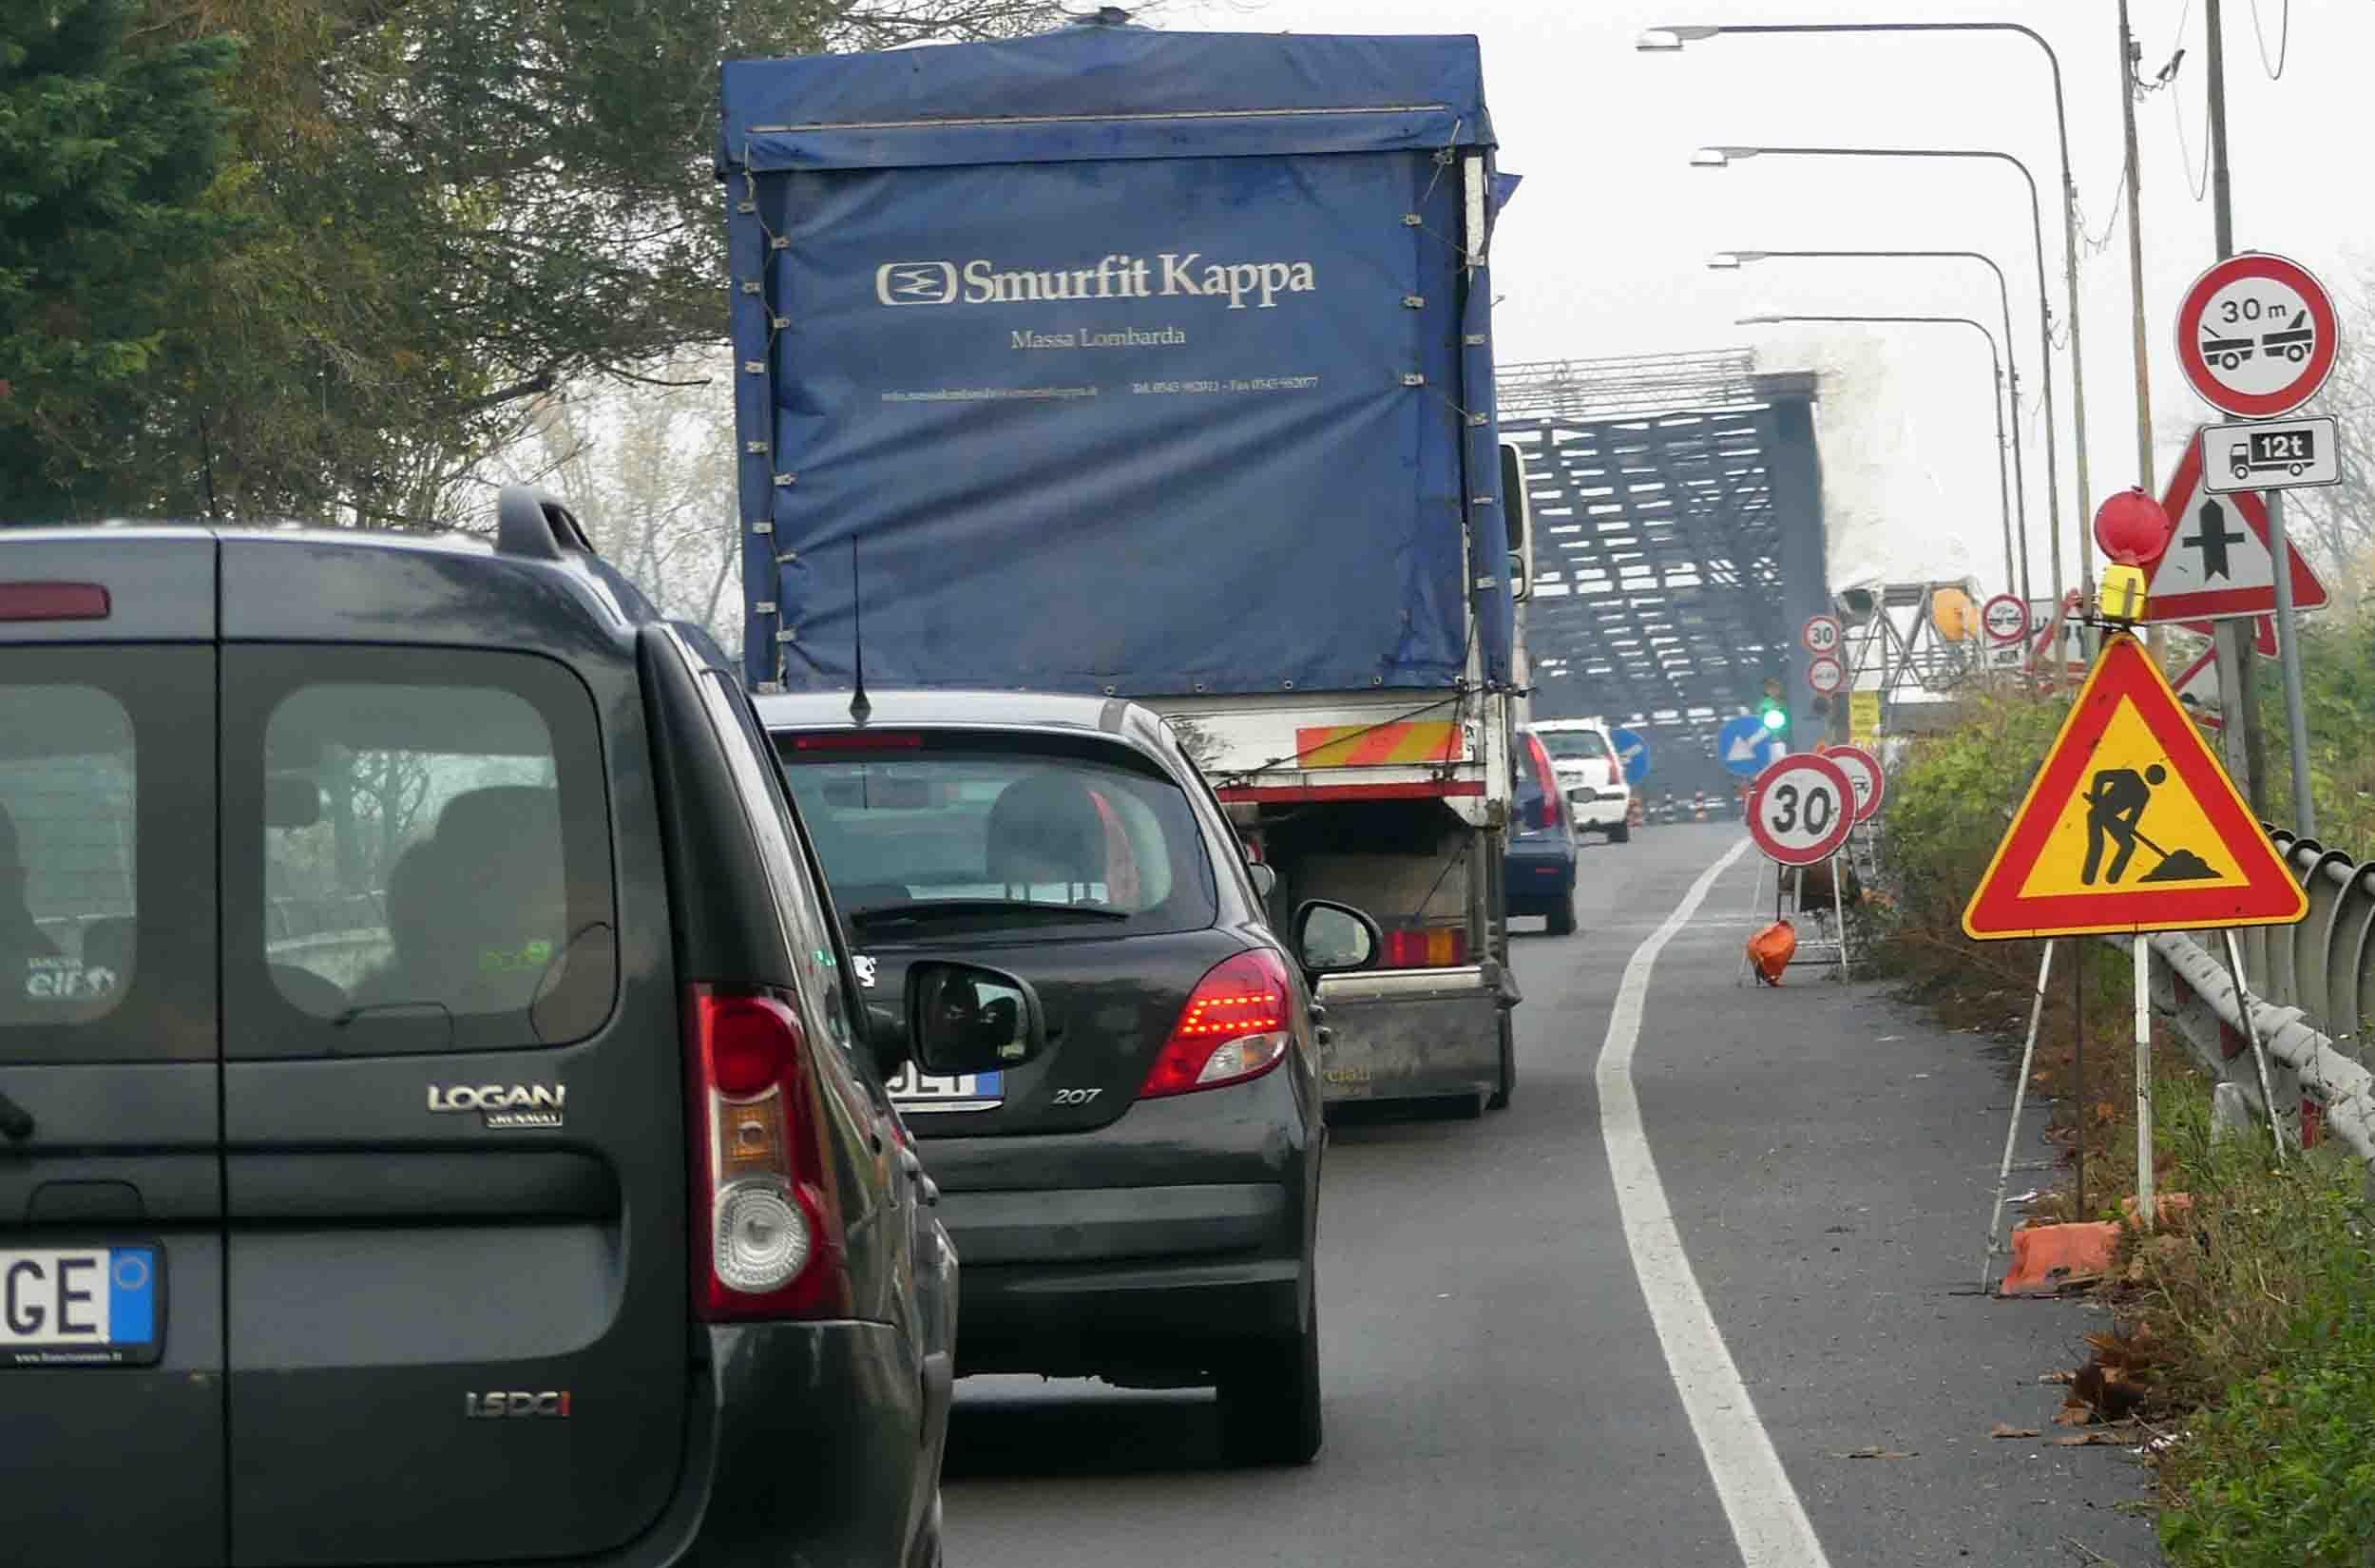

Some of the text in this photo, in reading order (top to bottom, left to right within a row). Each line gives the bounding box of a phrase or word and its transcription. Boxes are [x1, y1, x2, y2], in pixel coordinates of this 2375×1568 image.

[964, 253, 1316, 309] Smurfit Kappa
[2221, 297, 2287, 323] 30 m
[1010, 325, 1186, 349] Massa Lombarda
[2261, 435, 2304, 459] 12t
[1811, 626, 1833, 644] 30
[1772, 784, 1831, 836] 30
[428, 1084, 565, 1111] LOGAN
[1052, 1088, 1103, 1104] 207
[5, 1258, 97, 1335] GE
